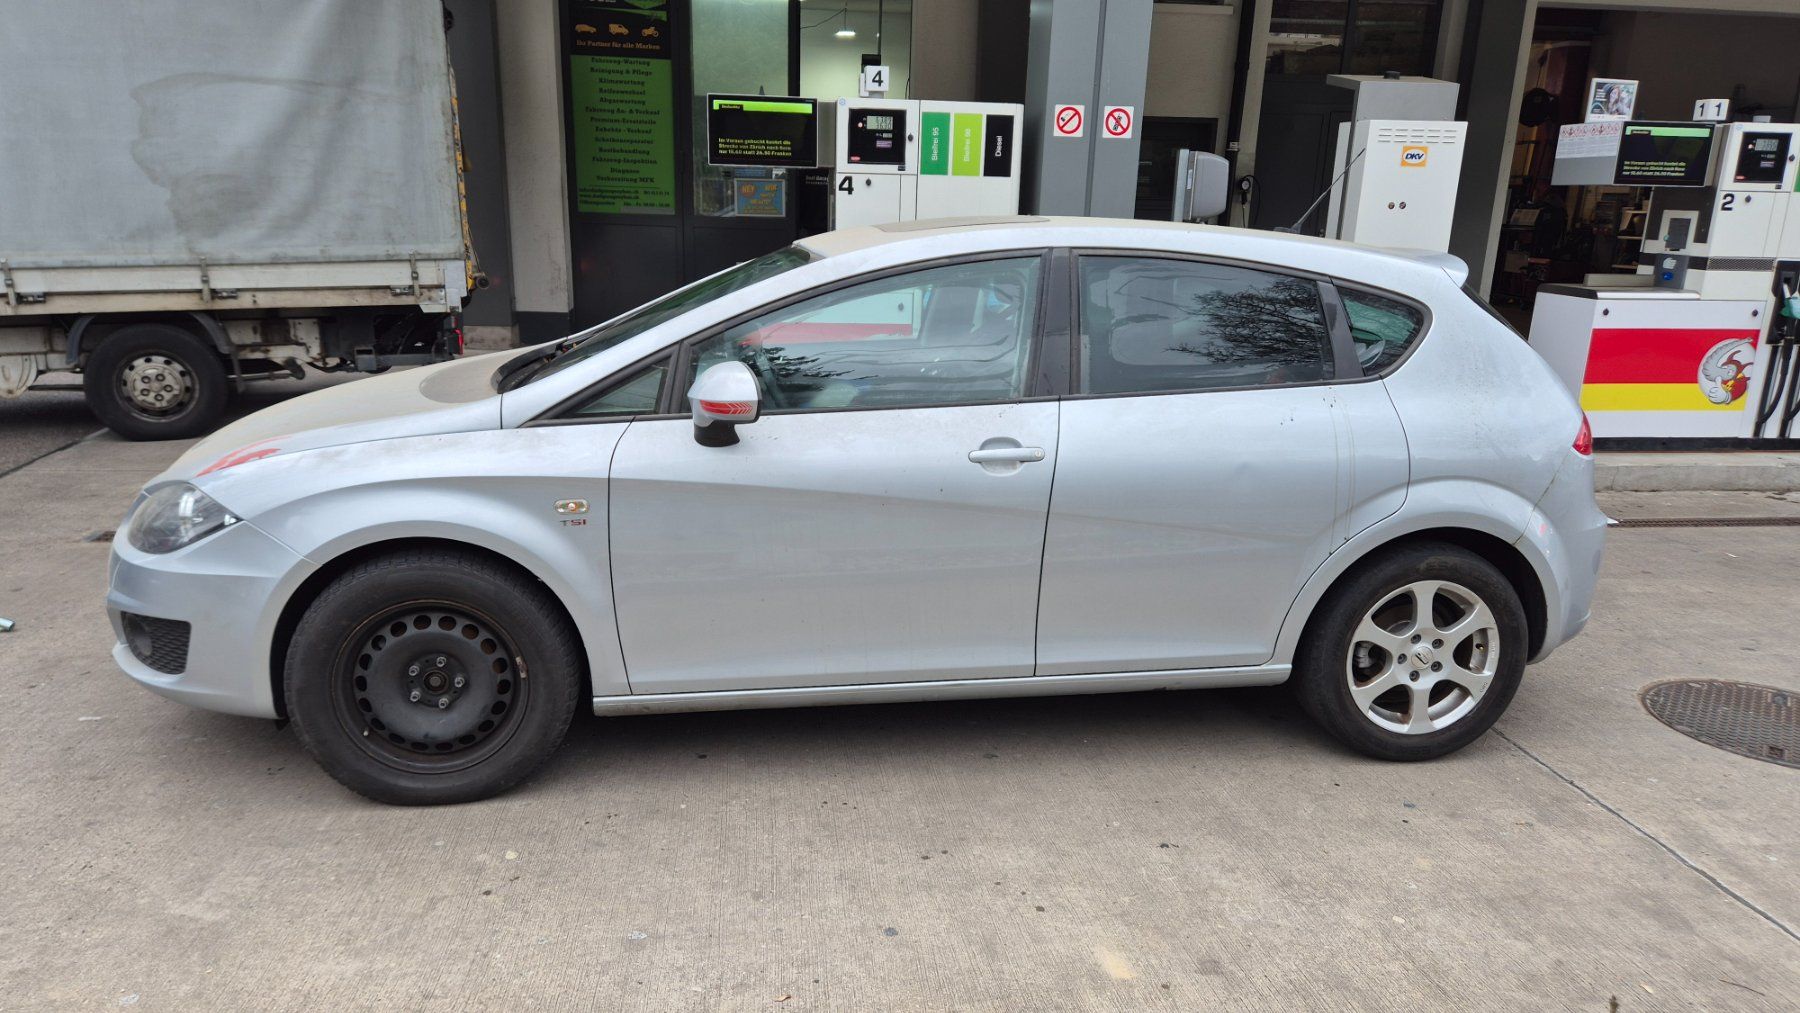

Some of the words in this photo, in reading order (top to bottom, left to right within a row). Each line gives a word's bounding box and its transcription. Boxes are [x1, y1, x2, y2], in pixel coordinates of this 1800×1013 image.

[590, 67, 624, 75] Reinigung
[872, 70, 884, 87] 4
[1699, 102, 1705, 117] 1
[1714, 102, 1722, 117] 1
[932, 127, 939, 136] 95
[995, 136, 1003, 157] Diesel
[838, 176, 854, 195] 4
[1721, 193, 1735, 211] 2
